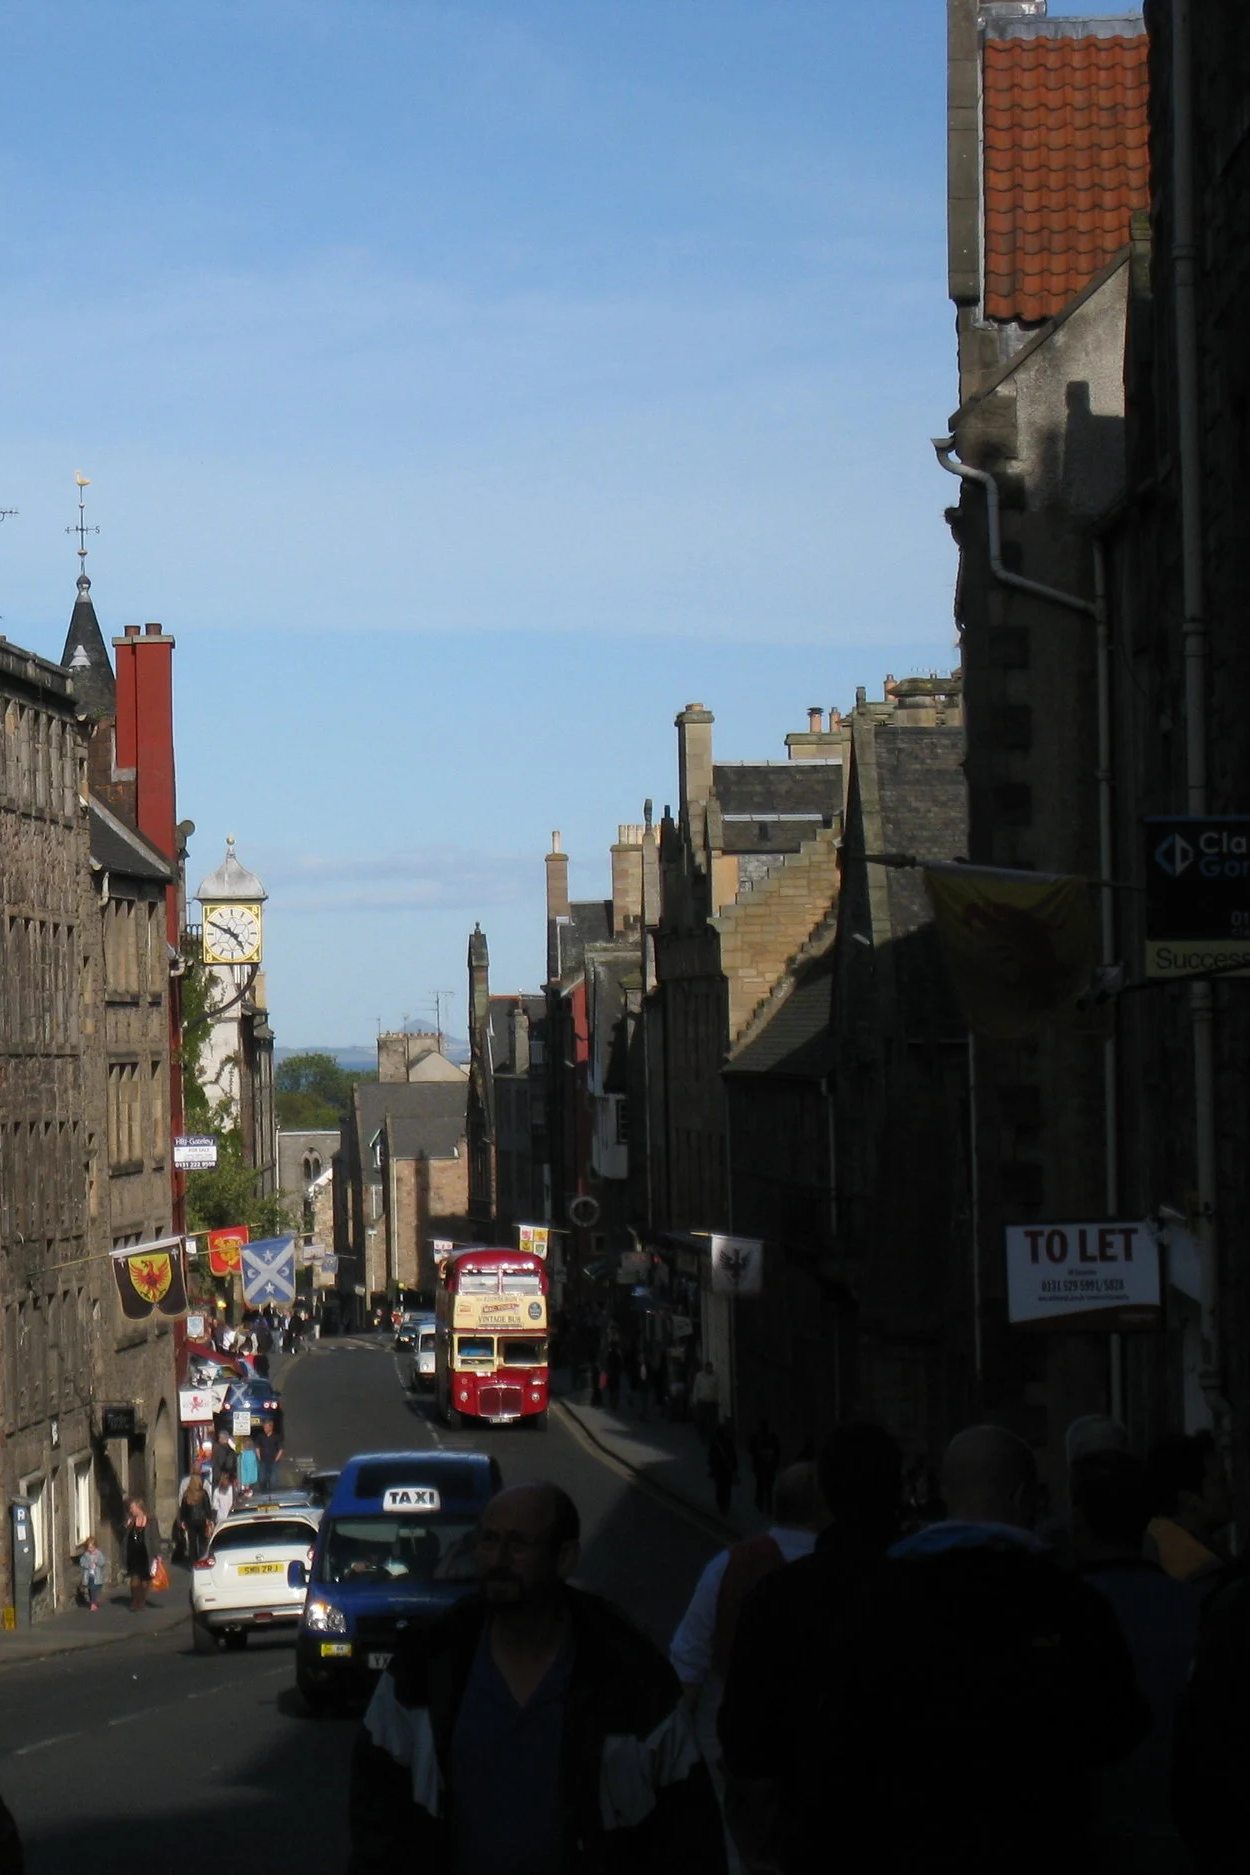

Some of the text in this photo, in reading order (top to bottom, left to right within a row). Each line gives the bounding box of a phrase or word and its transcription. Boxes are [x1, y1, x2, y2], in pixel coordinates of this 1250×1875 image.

[1023, 1228, 1138, 1264] TO LET
[1041, 1279, 1061, 1292] 0131
[1063, 1279, 1078, 1291] 529
[389, 1491, 435, 1505] TAXI
